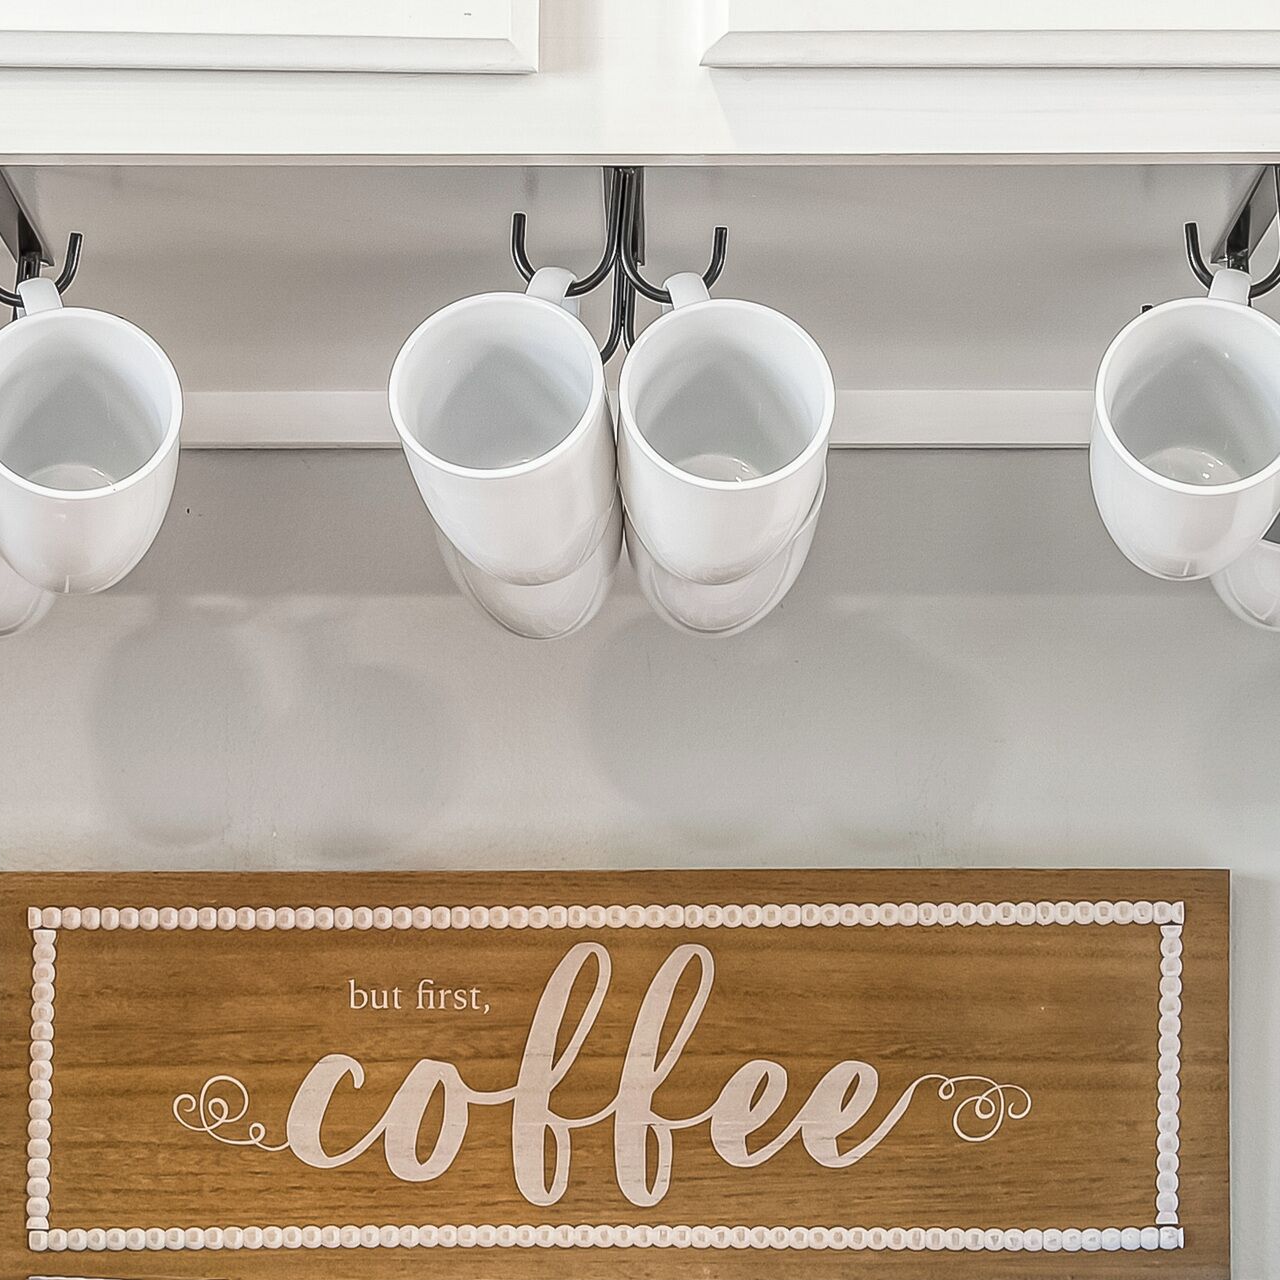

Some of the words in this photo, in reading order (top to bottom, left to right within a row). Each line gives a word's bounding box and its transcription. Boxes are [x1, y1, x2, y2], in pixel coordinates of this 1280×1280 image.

[348, 978, 403, 1011] but
[415, 978, 492, 1014] first,
[286, 941, 914, 1207] coffee
